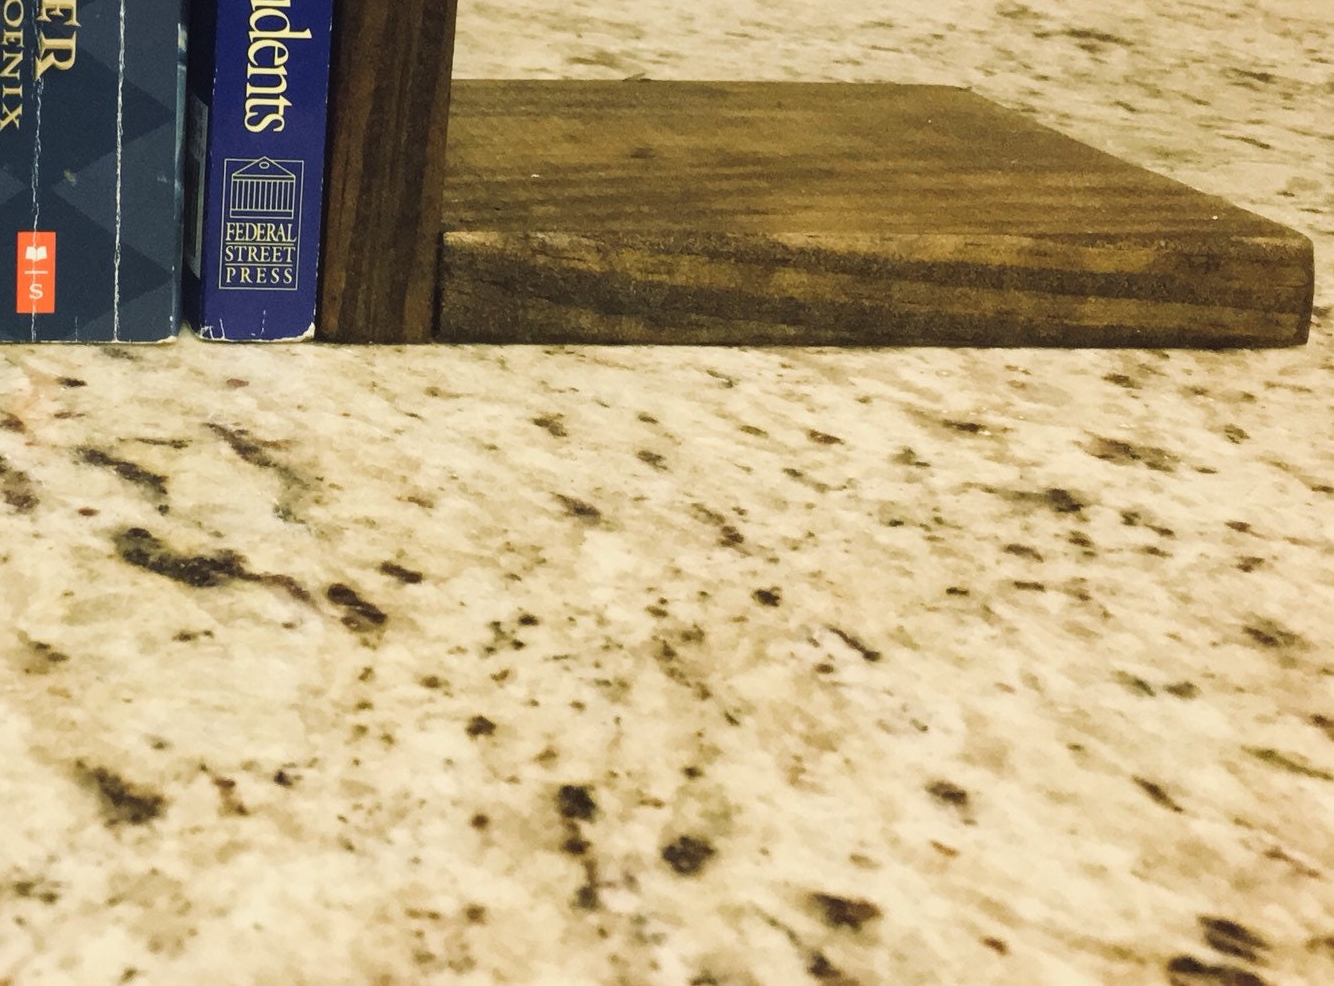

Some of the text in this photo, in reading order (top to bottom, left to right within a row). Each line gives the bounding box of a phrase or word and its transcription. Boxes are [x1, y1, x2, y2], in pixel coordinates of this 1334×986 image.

[225, 222, 297, 242] FEDERAL
[224, 245, 296, 263] STREET
[225, 267, 293, 284] PRESS
